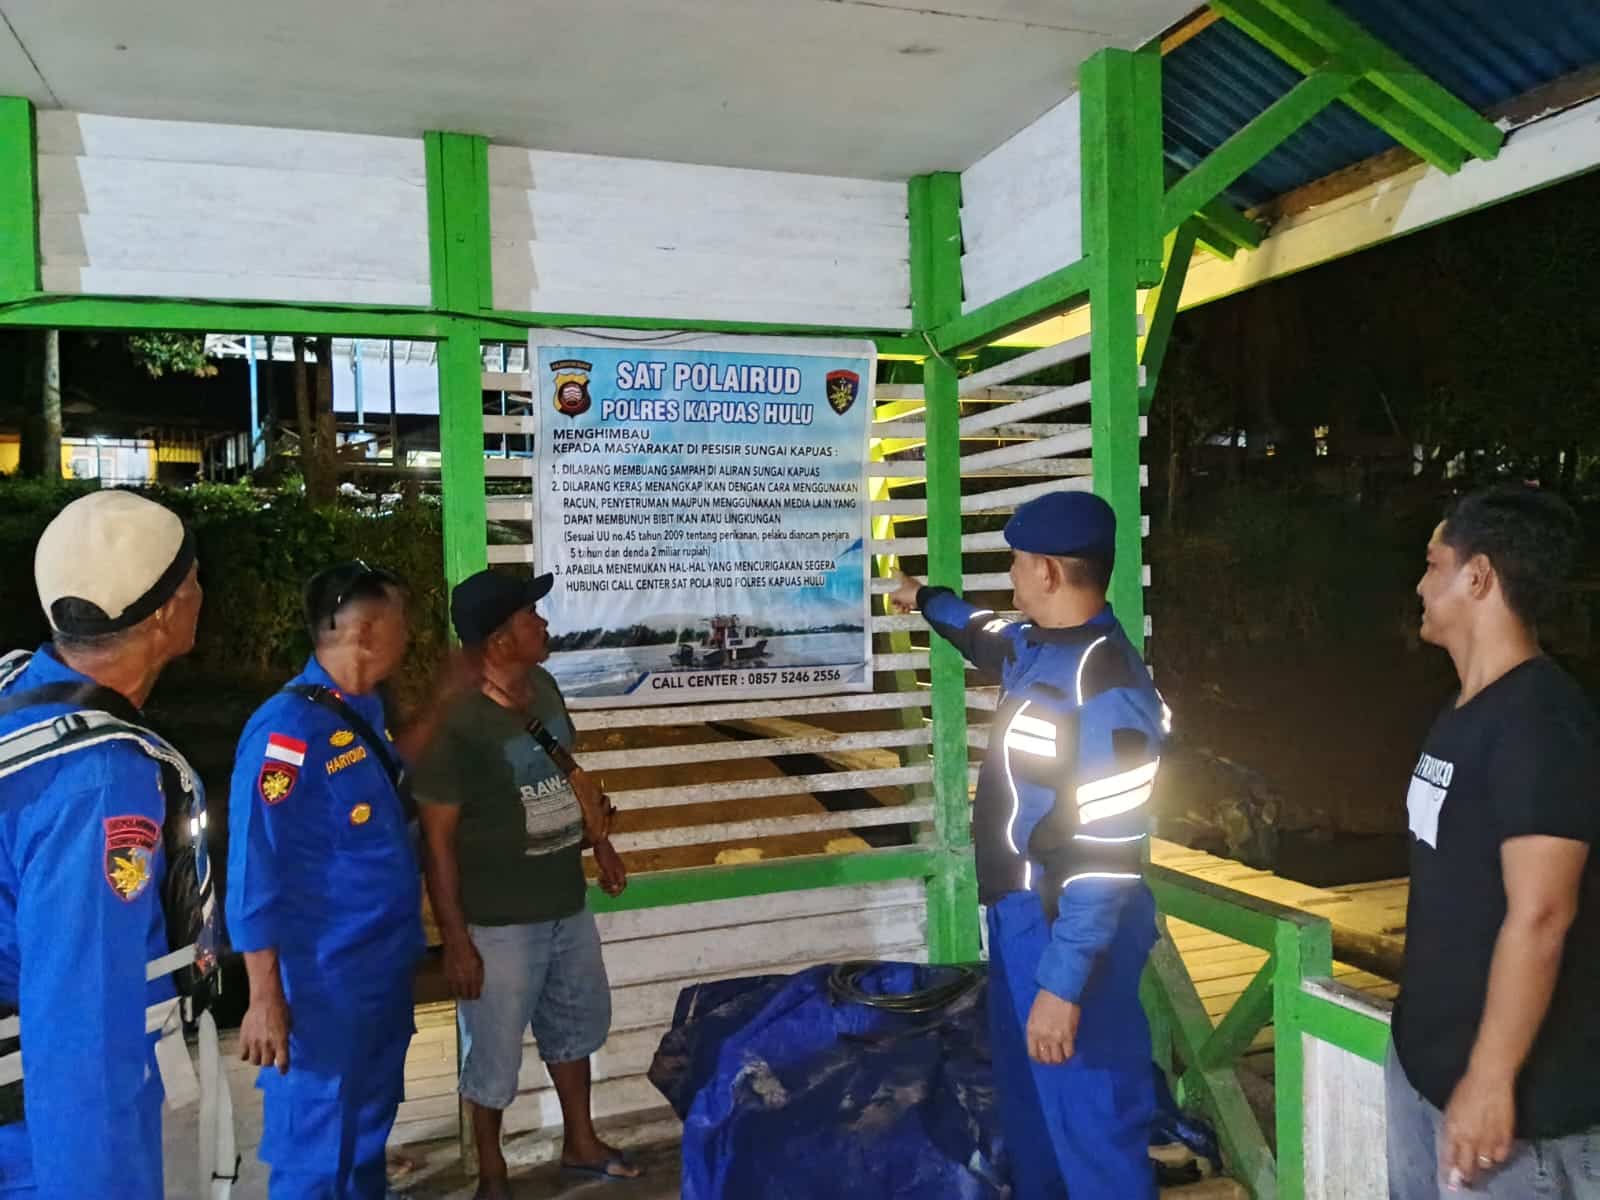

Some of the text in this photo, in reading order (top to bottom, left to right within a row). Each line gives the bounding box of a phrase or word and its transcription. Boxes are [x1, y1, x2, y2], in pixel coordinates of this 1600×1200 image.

[617, 361, 801, 394] SAT POLAIRUD
[601, 398, 814, 425] POLRES KAPUAS HULU
[553, 428, 650, 440] MENGHIMBAU
[552, 443, 600, 454] KEPADA
[604, 443, 684, 454] MASYARAKAT
[687, 444, 698, 454] DI
[702, 444, 741, 455] PESISIR
[745, 445, 787, 456] SUNGAI
[790, 446, 832, 456] KAPUAS
[552, 464, 820, 477] 1. DILARANG MEMBUANG SAMPAH DI ALIRAN SUNGAI KAPUAS
[552, 481, 858, 493] 2. DILARANG KERAS MENANGKAP IKAN DENGAN CARA MENGGUNAKAN
[563, 498, 856, 509] RACUN, PENYETRUMAN MAUPUN MENGGUNAKAN MEDIA LAIN YANG
[563, 513, 781, 525] DAPAT MEMBUNUH BIBIT IKAN ATAU LINGKUNGAN
[564, 531, 594, 543] (Sesuai
[597, 531, 610, 541] UU
[612, 531, 636, 541] no.45
[638, 531, 662, 540] tahun
[664, 530, 684, 540] 2009
[686, 530, 717, 543] tentang
[762, 530, 787, 542] pelaku
[789, 530, 821, 540] diancam
[822, 530, 850, 543] penjara
[570, 548, 576, 558] 5
[605, 548, 620, 558] dan
[623, 547, 649, 558] denda
[651, 547, 656, 557] 2
[658, 547, 680, 556] miliar
[565, 564, 603, 575] APABILA
[606, 564, 666, 574] MENEMUKAN
[669, 562, 706, 573] HAL-HAL
[708, 561, 732, 572] YANG
[734, 561, 804, 572] MENCURIGAKAN
[806, 560, 835, 570] SEGERA
[566, 581, 609, 592] HUBUNGI
[612, 580, 633, 591] CALL
[636, 579, 669, 590] CENTER
[671, 579, 687, 588] SAT
[690, 577, 732, 588] POLAIRUD
[768, 576, 801, 587] KAPUAS
[804, 576, 824, 586] HULU
[652, 675, 684, 689] CALL
[688, 673, 737, 688] CENTER
[748, 671, 777, 684] 0857
[781, 671, 810, 684] 5246
[813, 669, 841, 682] 2556
